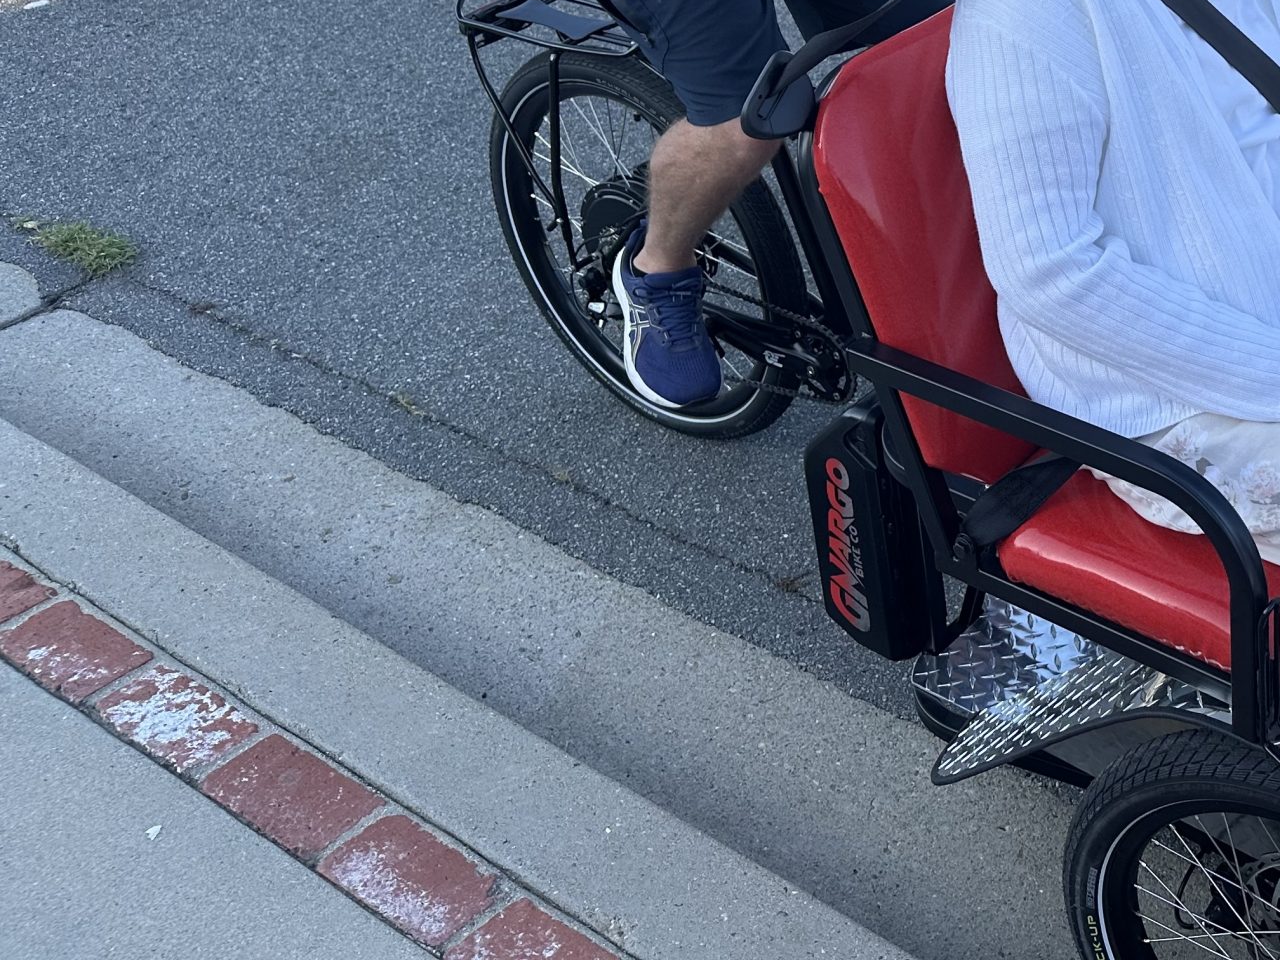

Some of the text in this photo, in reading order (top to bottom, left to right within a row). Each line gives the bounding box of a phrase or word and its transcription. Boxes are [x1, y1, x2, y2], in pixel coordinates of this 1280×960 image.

[825, 457, 871, 633] GNARGO
[848, 525, 865, 579] BIKE CO
[1087, 915, 1106, 960] CK-UP
